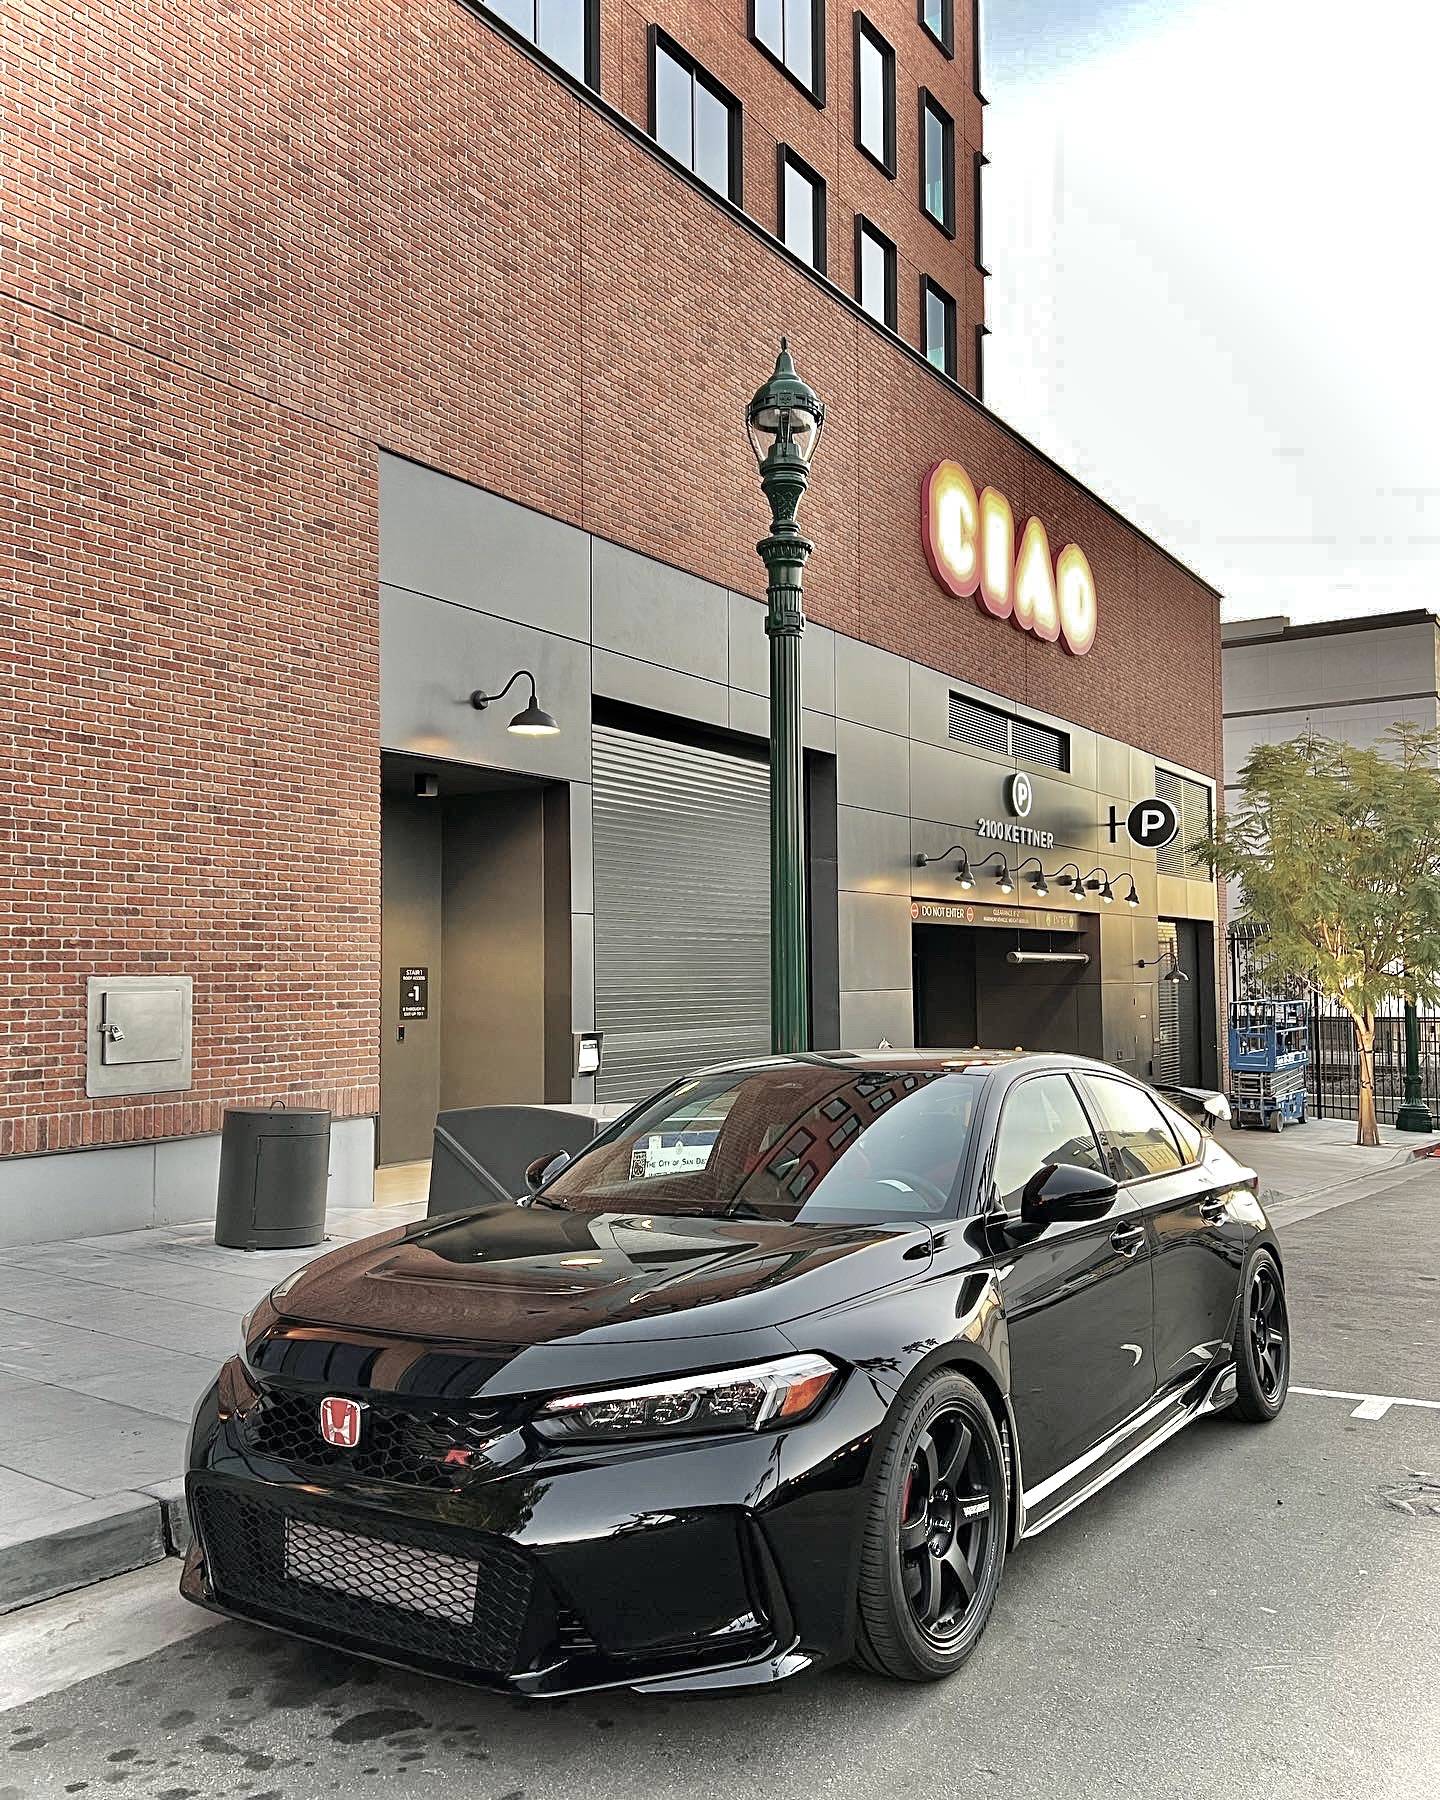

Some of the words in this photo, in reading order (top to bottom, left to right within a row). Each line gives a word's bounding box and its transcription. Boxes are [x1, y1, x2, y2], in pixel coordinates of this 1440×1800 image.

[921, 459, 1098, 656] CIAO
[1017, 782, 1028, 806] P
[978, 817, 1004, 840] 2100
[1004, 823, 1054, 849] KETTNER
[1141, 809, 1166, 837] P
[921, 905, 932, 916] DO
[932, 906, 946, 917] NOT
[945, 907, 965, 919] ENTER
